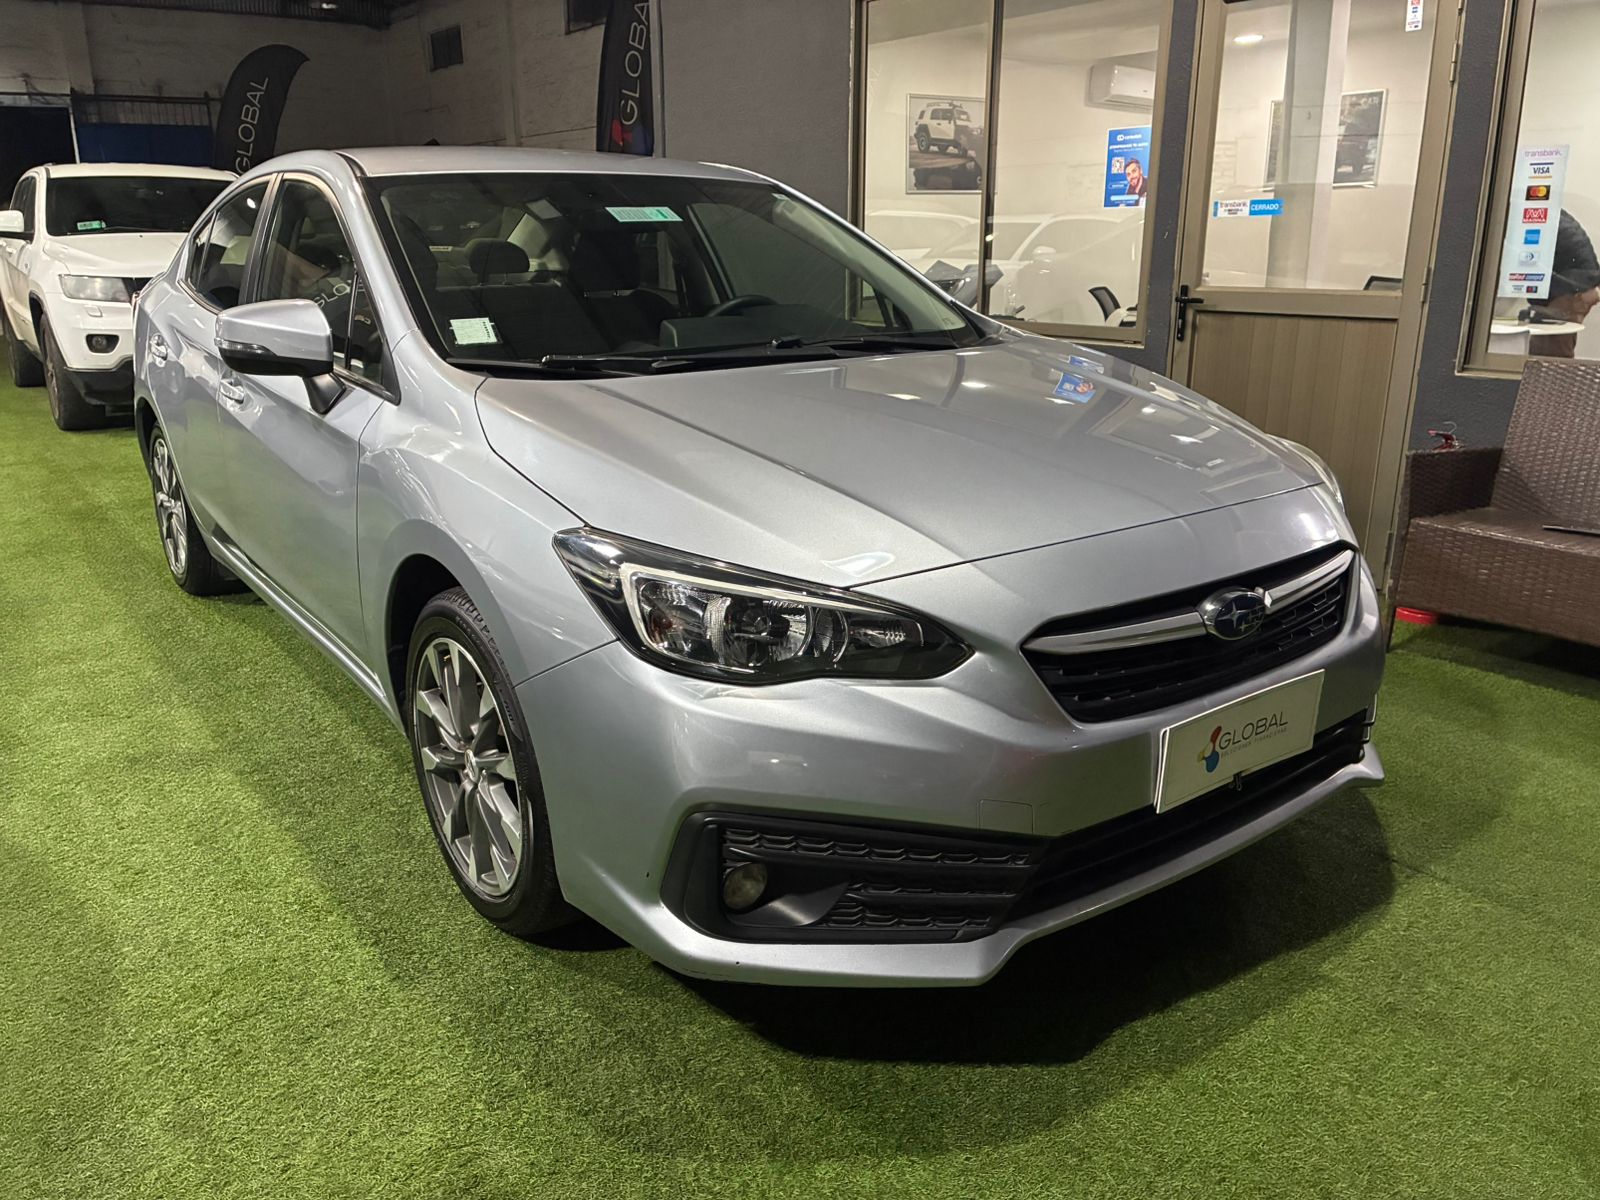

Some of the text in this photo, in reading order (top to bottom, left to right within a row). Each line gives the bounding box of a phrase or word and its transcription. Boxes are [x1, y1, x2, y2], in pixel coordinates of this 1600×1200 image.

[235, 77, 269, 174] GLOBAL
[1532, 166, 1550, 174] VISA
[1250, 203, 1279, 211] CERRADO
[1218, 712, 1289, 750] GLOBAL
